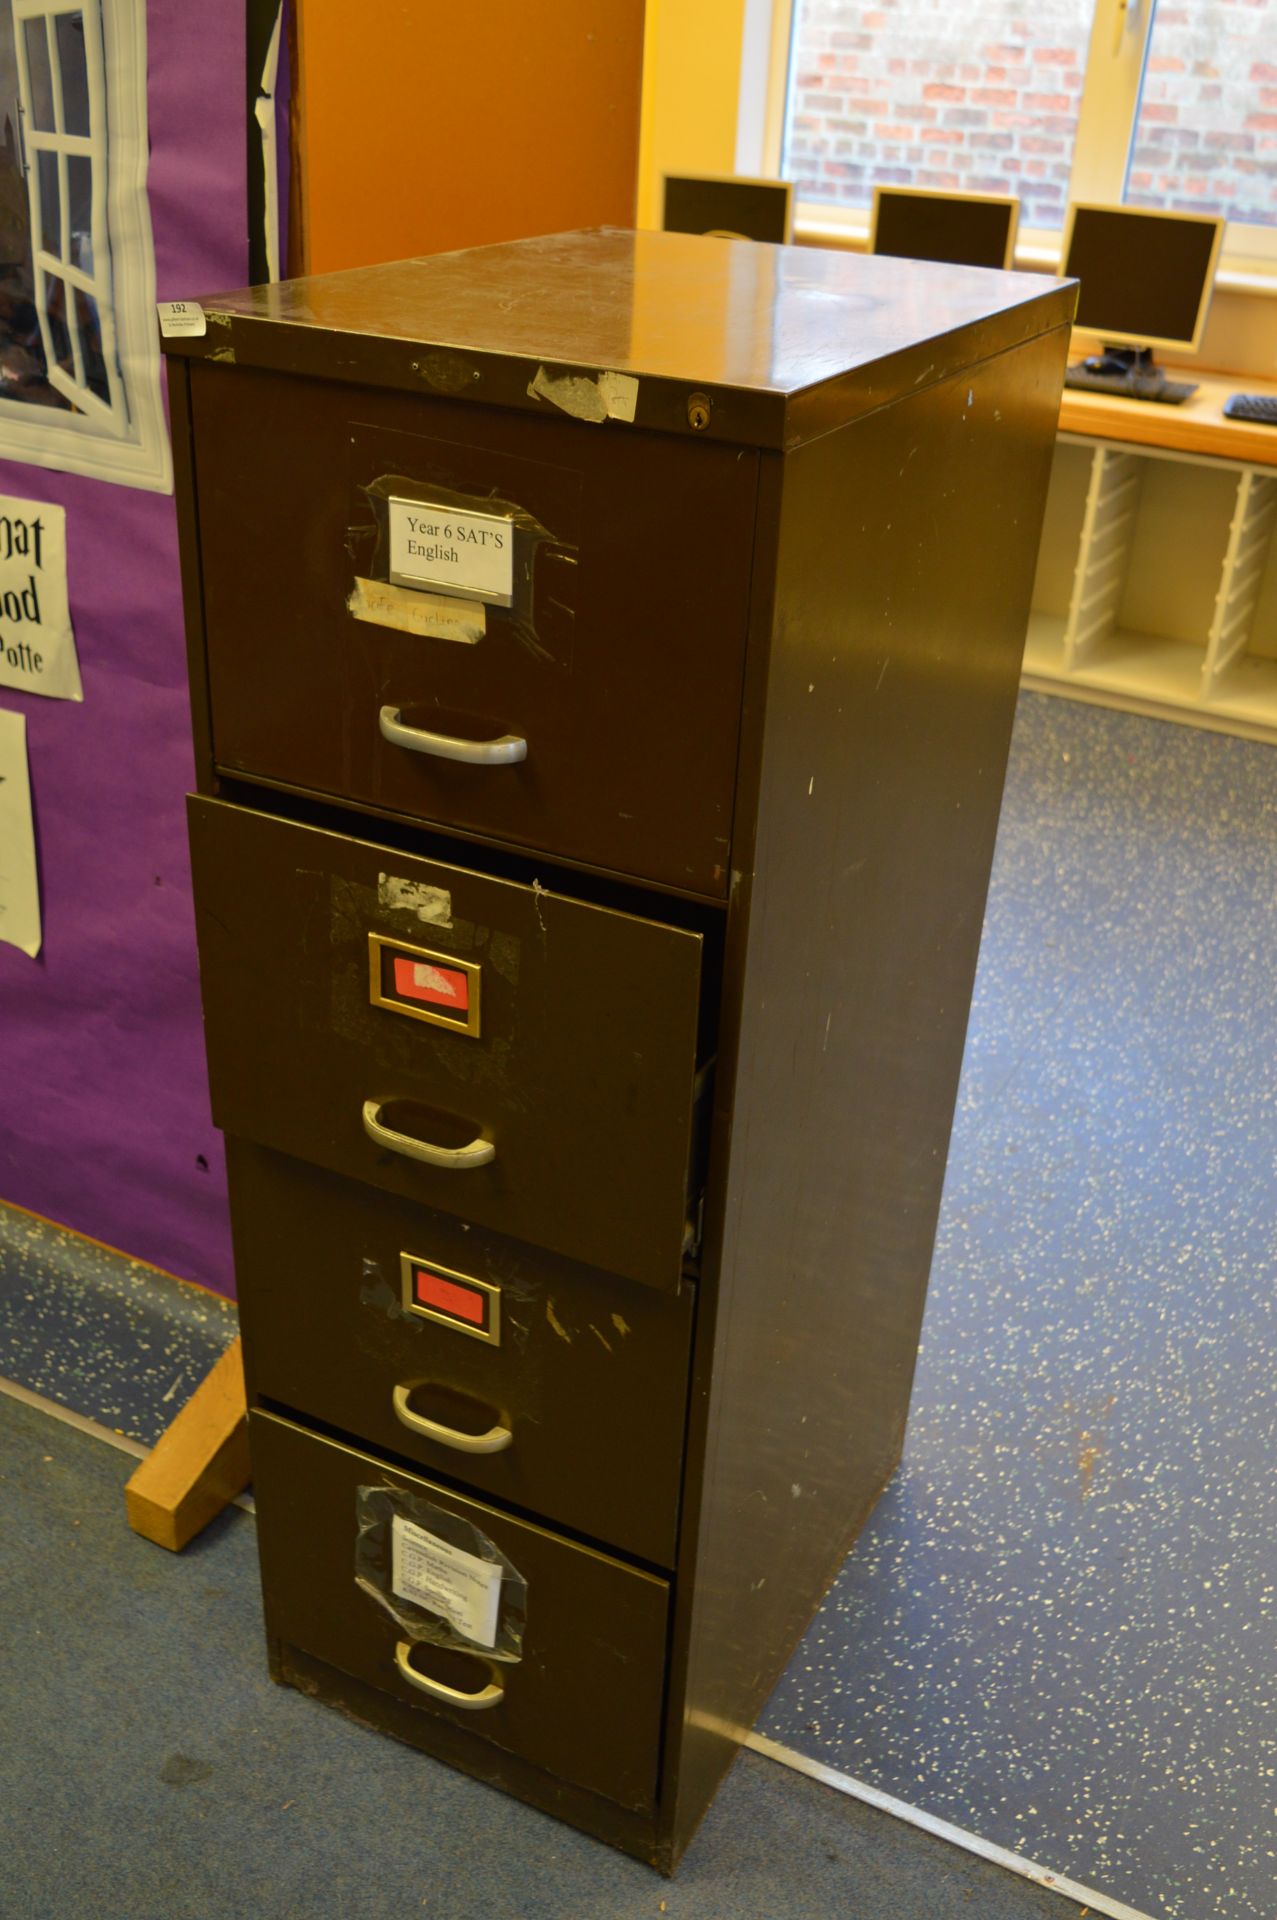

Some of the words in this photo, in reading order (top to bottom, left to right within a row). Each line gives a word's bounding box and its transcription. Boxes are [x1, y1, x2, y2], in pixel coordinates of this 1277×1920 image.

[170, 303, 187, 313] 192
[407, 517, 440, 536] Year
[444, 525, 452, 539] 6
[457, 527, 504, 549] SAT'S
[407, 540, 459, 562] English
[0, 575, 42, 625] od
[403, 1524, 452, 1556] Miscellaneous
